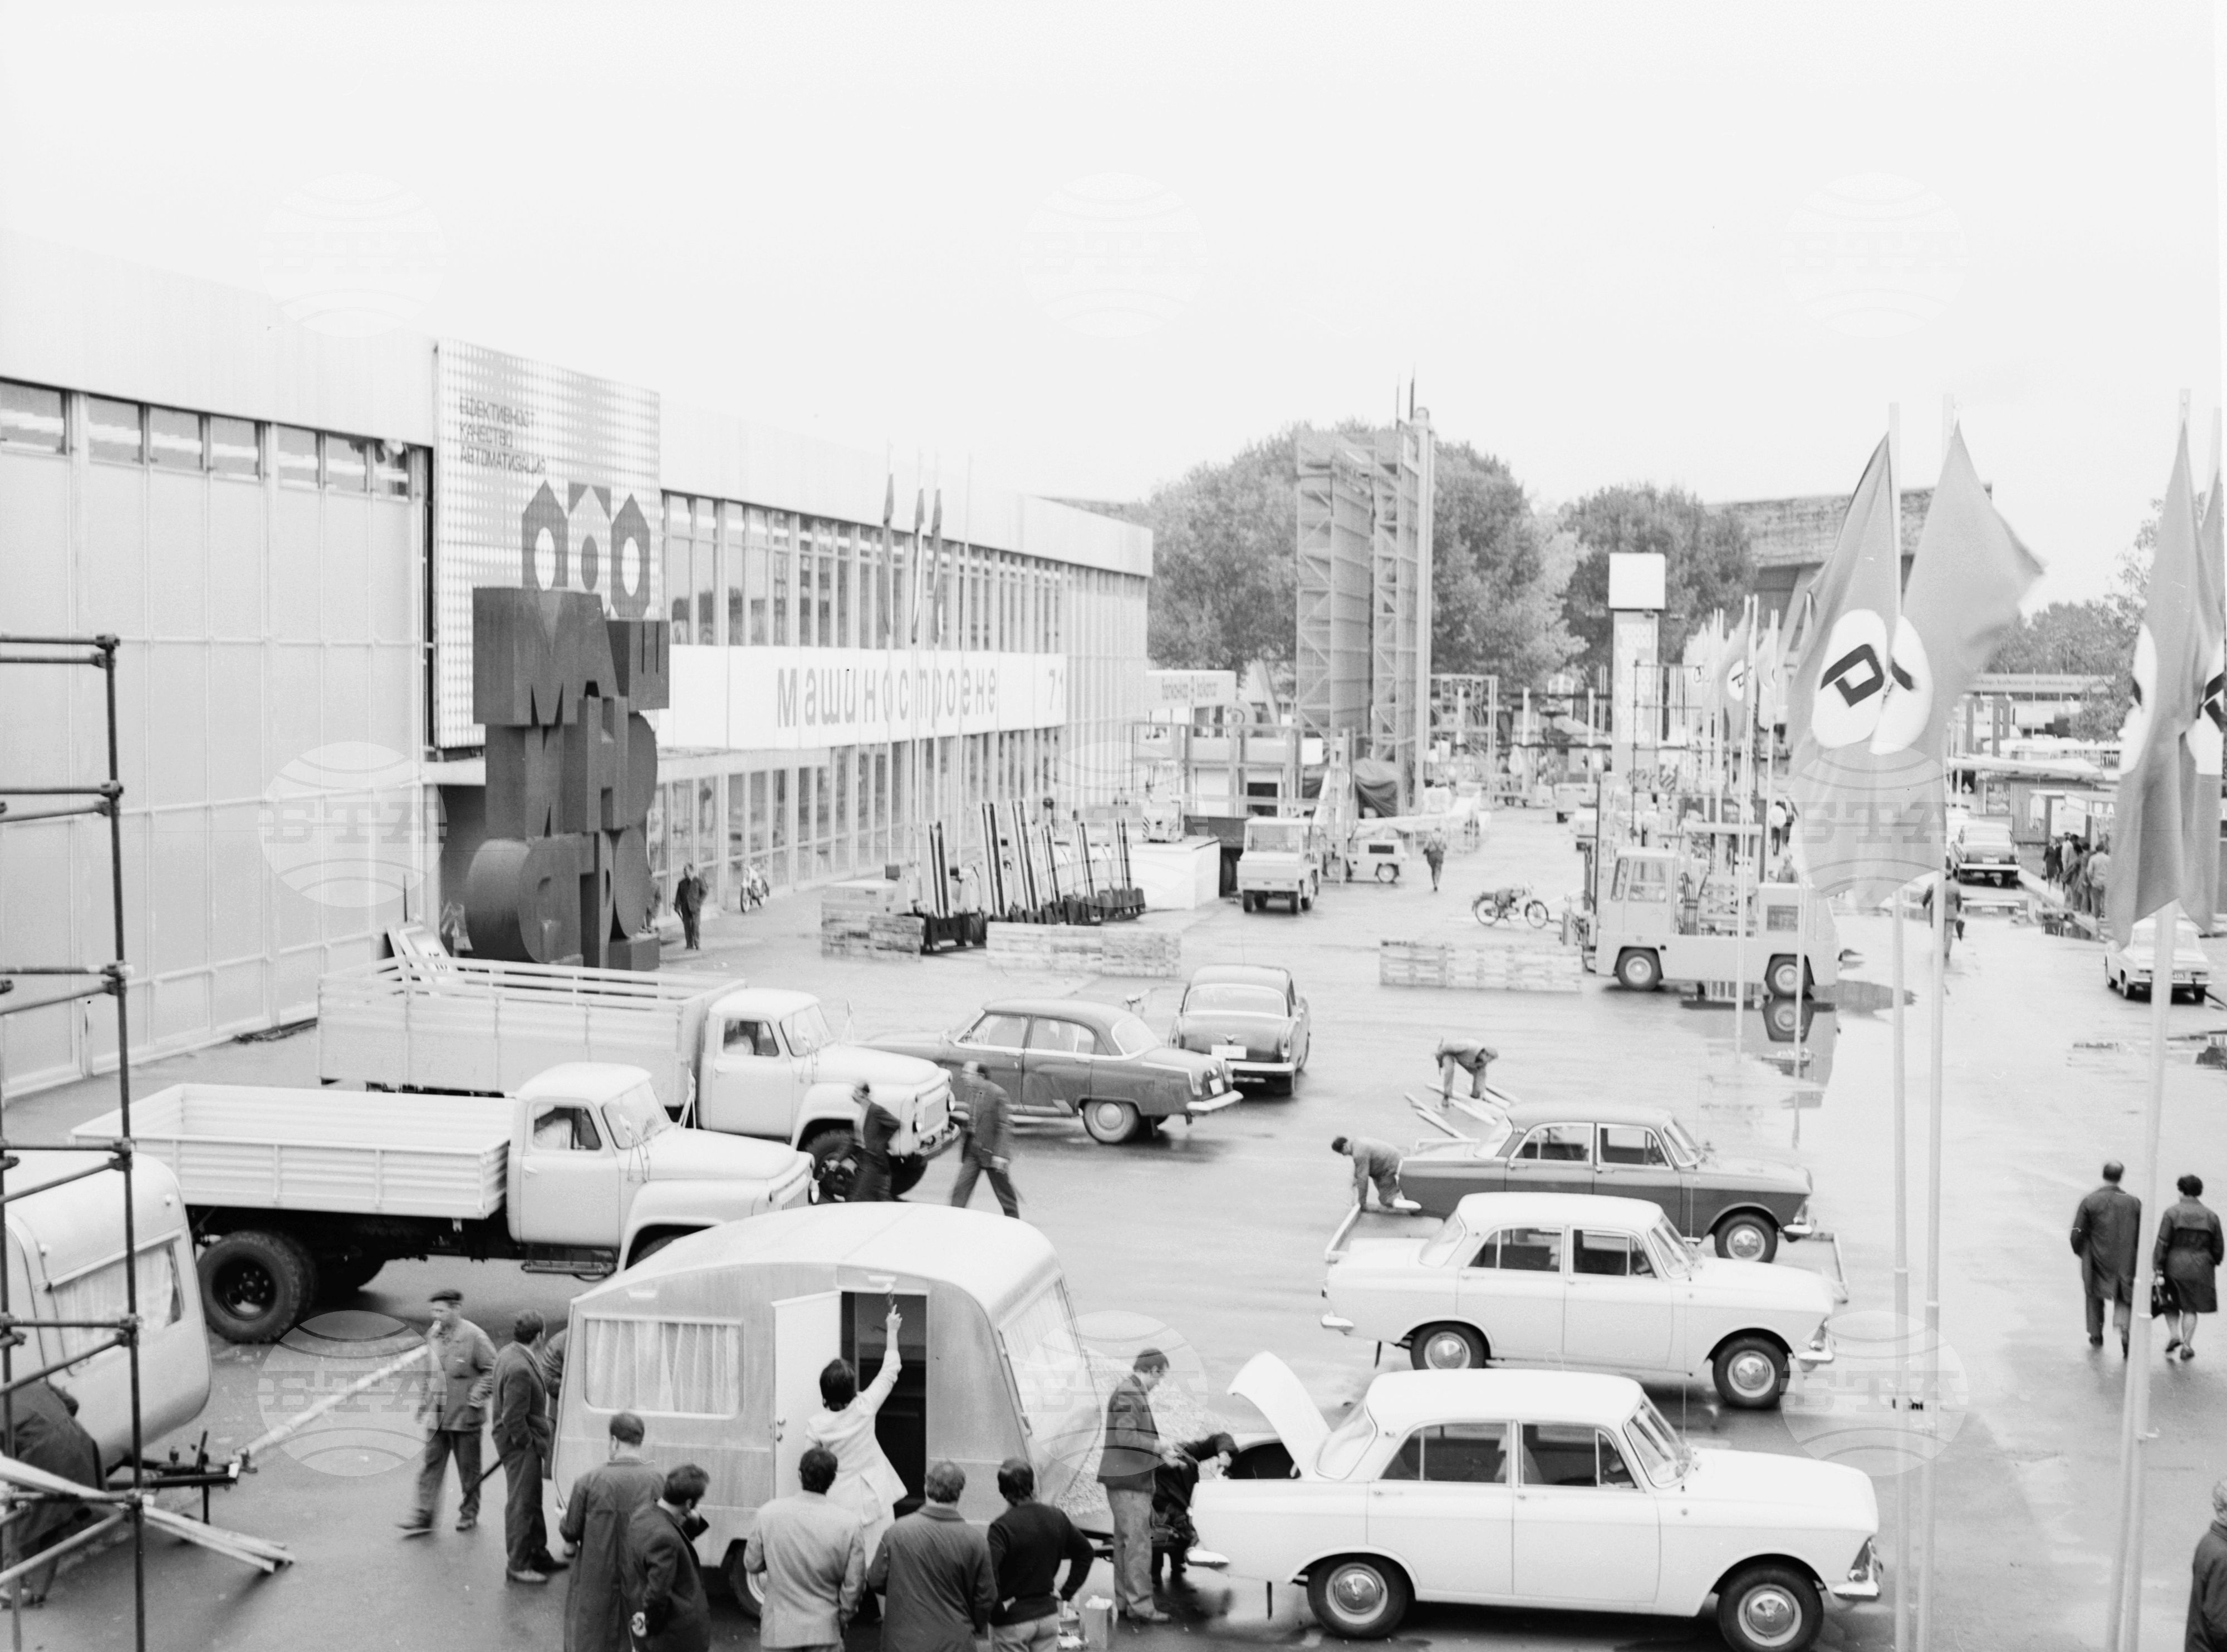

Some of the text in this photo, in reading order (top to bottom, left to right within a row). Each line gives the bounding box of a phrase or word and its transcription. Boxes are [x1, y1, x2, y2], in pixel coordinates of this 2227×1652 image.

[460, 396, 534, 428] ЕФЕКТИВНОСТ
[459, 421, 513, 449] КАЧЕСТВО
[460, 445, 546, 476] АВТОМАТИЗАЦИЯ
[1049, 668, 1063, 710] 71
